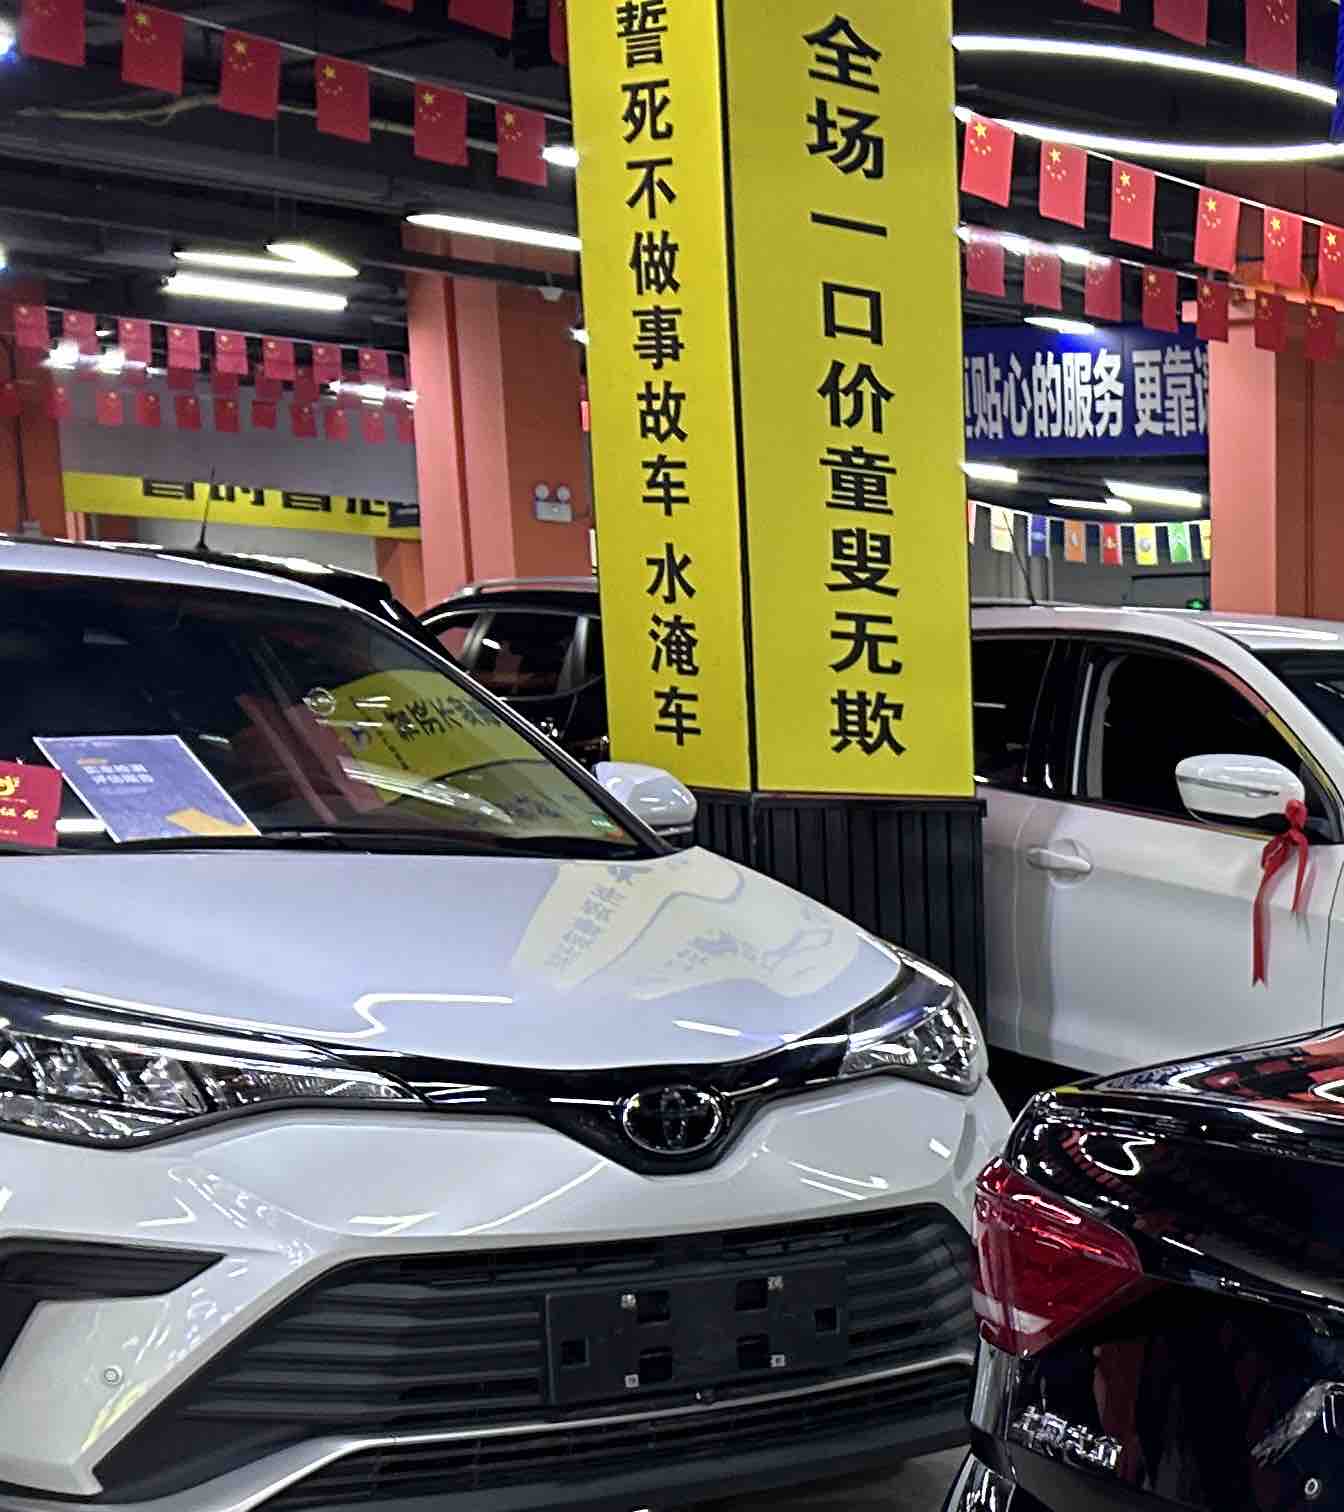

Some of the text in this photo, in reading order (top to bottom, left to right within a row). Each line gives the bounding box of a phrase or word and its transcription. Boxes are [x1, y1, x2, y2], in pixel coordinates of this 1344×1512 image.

[616, 0, 702, 746] 誓死不做事故车 水淹车
[802, 14, 906, 756] 全场一口价童叟无欺
[964, 350, 1124, 439] 贴心的服务
